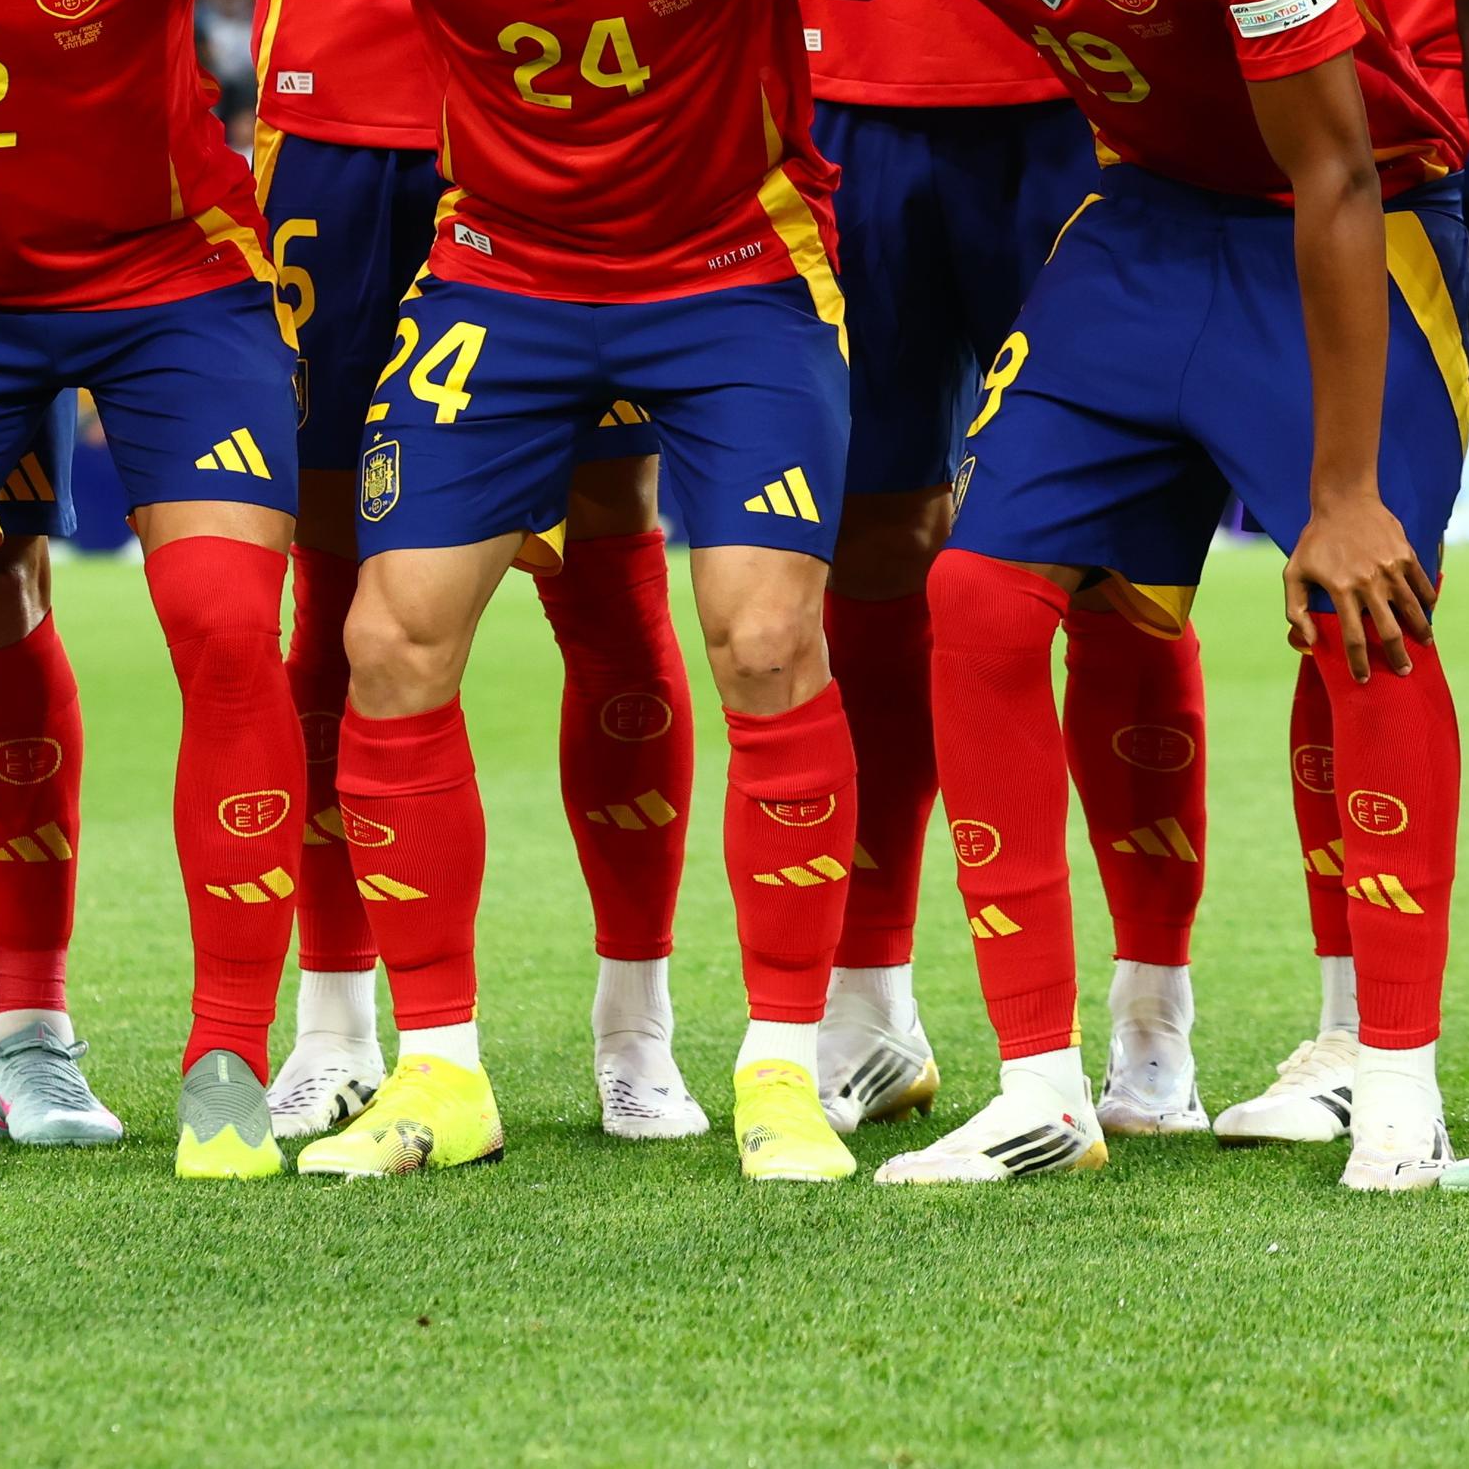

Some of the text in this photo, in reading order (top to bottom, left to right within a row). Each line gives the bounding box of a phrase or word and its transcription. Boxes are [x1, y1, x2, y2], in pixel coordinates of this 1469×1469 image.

[1236, 0, 1307, 25] FOUNDATION
[62, 35, 98, 50] STUTTGART
[498, 16, 651, 110] 24
[1031, 24, 1151, 103] 19
[707, 240, 763, 271] HEAT.RDY
[365, 317, 487, 425] 24
[234, 798, 273, 814] RF
[1356, 798, 1389, 812] RF
[235, 810, 275, 828] EF
[1358, 811, 1390, 825] EF
[956, 830, 982, 842] RF
[959, 843, 985, 857] EF
